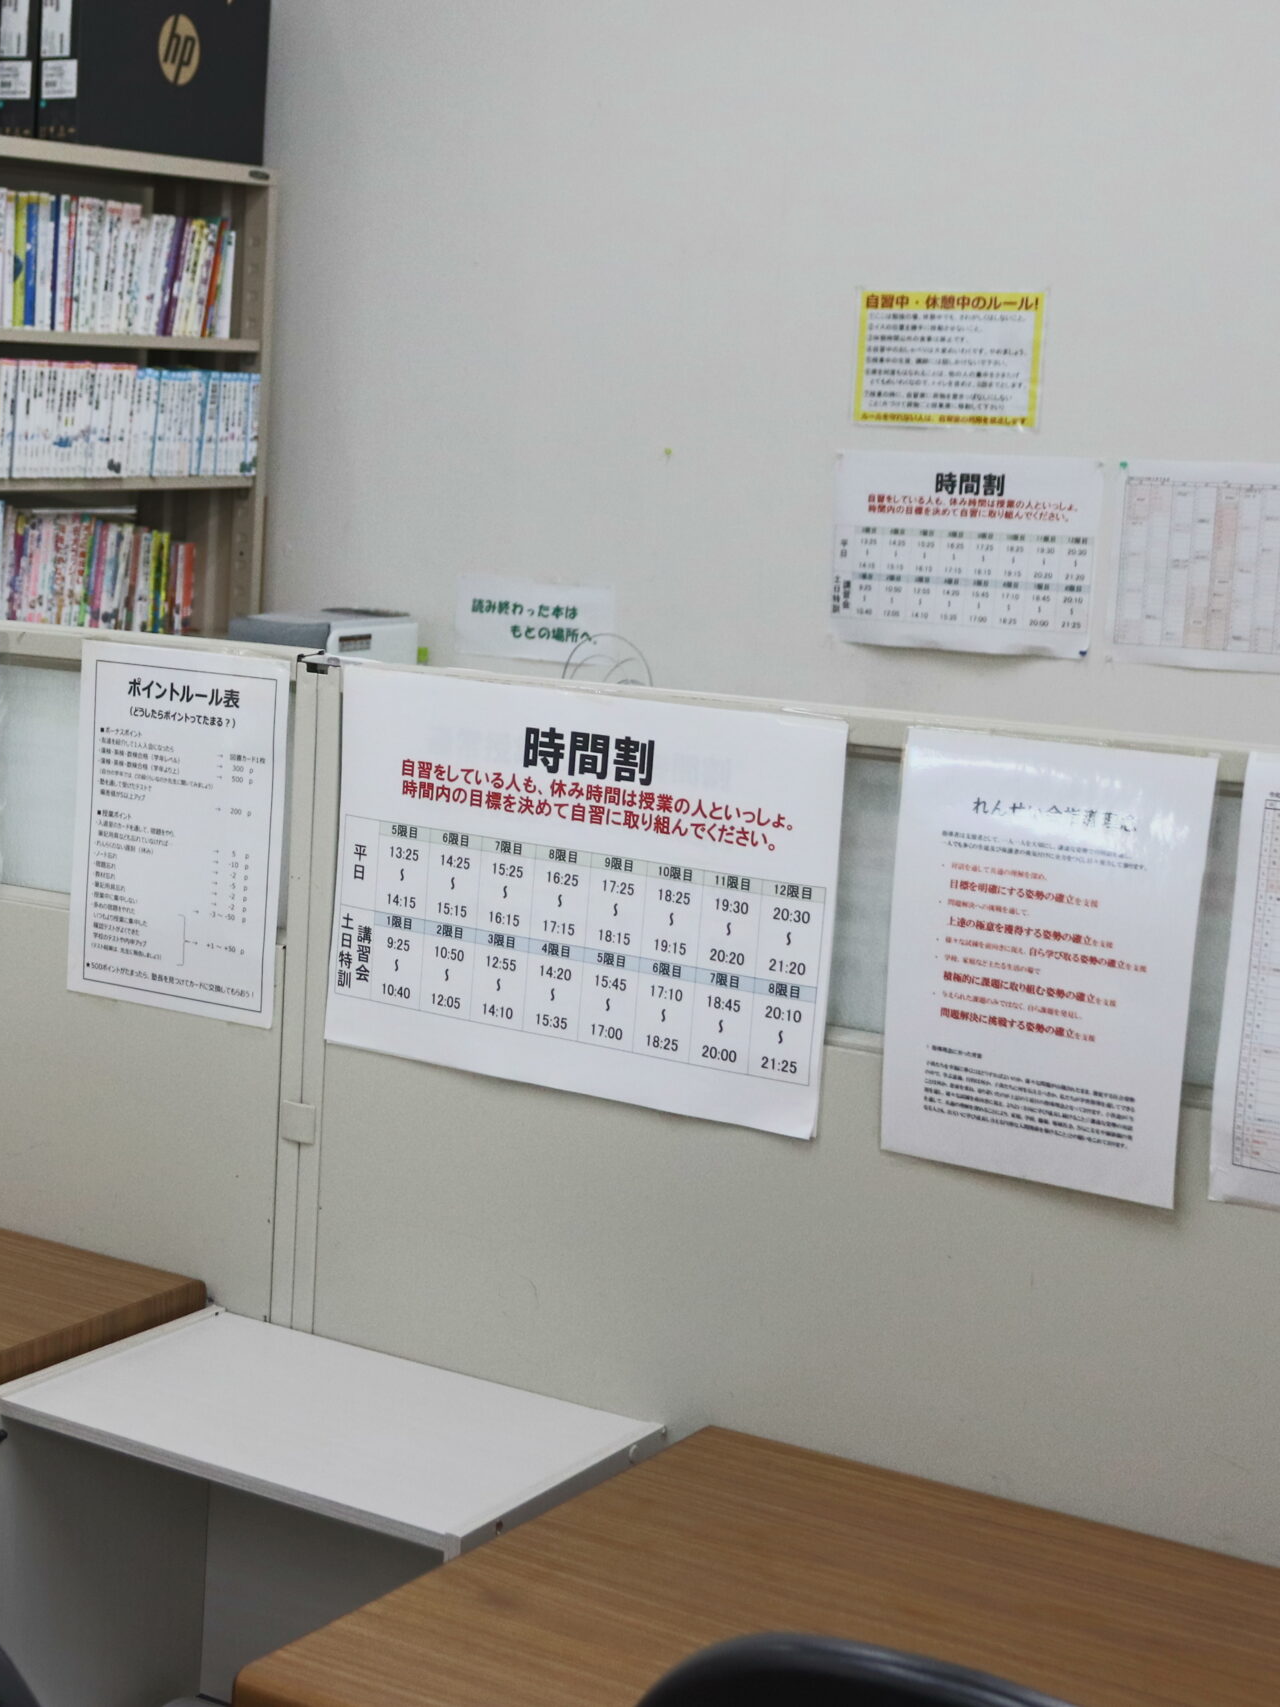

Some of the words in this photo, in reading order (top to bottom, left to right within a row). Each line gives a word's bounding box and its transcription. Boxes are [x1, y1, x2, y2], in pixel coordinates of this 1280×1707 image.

[160, 14, 198, 85] hp
[935, 472, 1005, 497] 時間割
[471, 598, 578, 620] 読み終わった本は
[127, 677, 241, 709] ポイントルール表
[522, 726, 656, 786] 時間割
[400, 758, 795, 833] 自習をしている人も、休み時間は授業の人といっしょ。
[401, 781, 777, 852] 時間内の目標を決めて自習に取り組んでください。
[354, 844, 367, 880] 平日
[391, 846, 418, 861] 13:25
[441, 854, 470, 870] 14:25
[493, 863, 523, 878] 15:25
[548, 872, 578, 887] 16:25
[603, 880, 634, 896] 17:25
[659, 889, 690, 905] 18:25
[716, 898, 748, 914] 19:30
[773, 907, 810, 924] 20:30
[392, 825, 417, 839] 5限目
[443, 832, 469, 847] 6限目
[496, 841, 522, 855] 7限目
[549, 849, 577, 864] 8限目
[605, 857, 633, 872] 9限目
[659, 866, 692, 882] 10限目
[716, 875, 750, 891] 11限目
[775, 884, 812, 900] 12限目
[338, 913, 354, 988] 土日特訓
[356, 925, 372, 982] 講習会
[387, 915, 412, 930] 1限目
[437, 924, 463, 939] 2限目
[488, 934, 515, 949] 3限目
[542, 943, 570, 958] 4限目
[597, 952, 625, 968] 5限目
[653, 961, 681, 978] 6限目
[710, 973, 739, 989] 7限目
[768, 982, 800, 999] 8限目
[388, 893, 416, 909] 14:15
[438, 902, 467, 918] 15:15
[490, 911, 519, 927] 16:15
[544, 920, 574, 936] 17:15
[600, 929, 630, 945] 18:15
[655, 939, 686, 955] 19:15
[710, 948, 744, 965] 20:20
[769, 958, 806, 975] 21:20
[387, 937, 410, 951] 9:25
[435, 946, 464, 962] 10:50
[487, 956, 516, 971] 12:55
[541, 965, 571, 981] 14:20
[596, 975, 626, 991] 15:45
[651, 985, 683, 1002] 17:10
[708, 996, 740, 1012] 18:45
[765, 1006, 801, 1023] 20:10
[383, 984, 410, 999] 10:40
[432, 993, 460, 1009] 12:05
[483, 1003, 513, 1019] 14:10
[537, 1014, 567, 1030] 15:35
[592, 1024, 622, 1040] 17:00
[647, 1035, 678, 1051] 18:25
[702, 1045, 737, 1063] 20:00
[761, 1056, 797, 1074] 21:25
